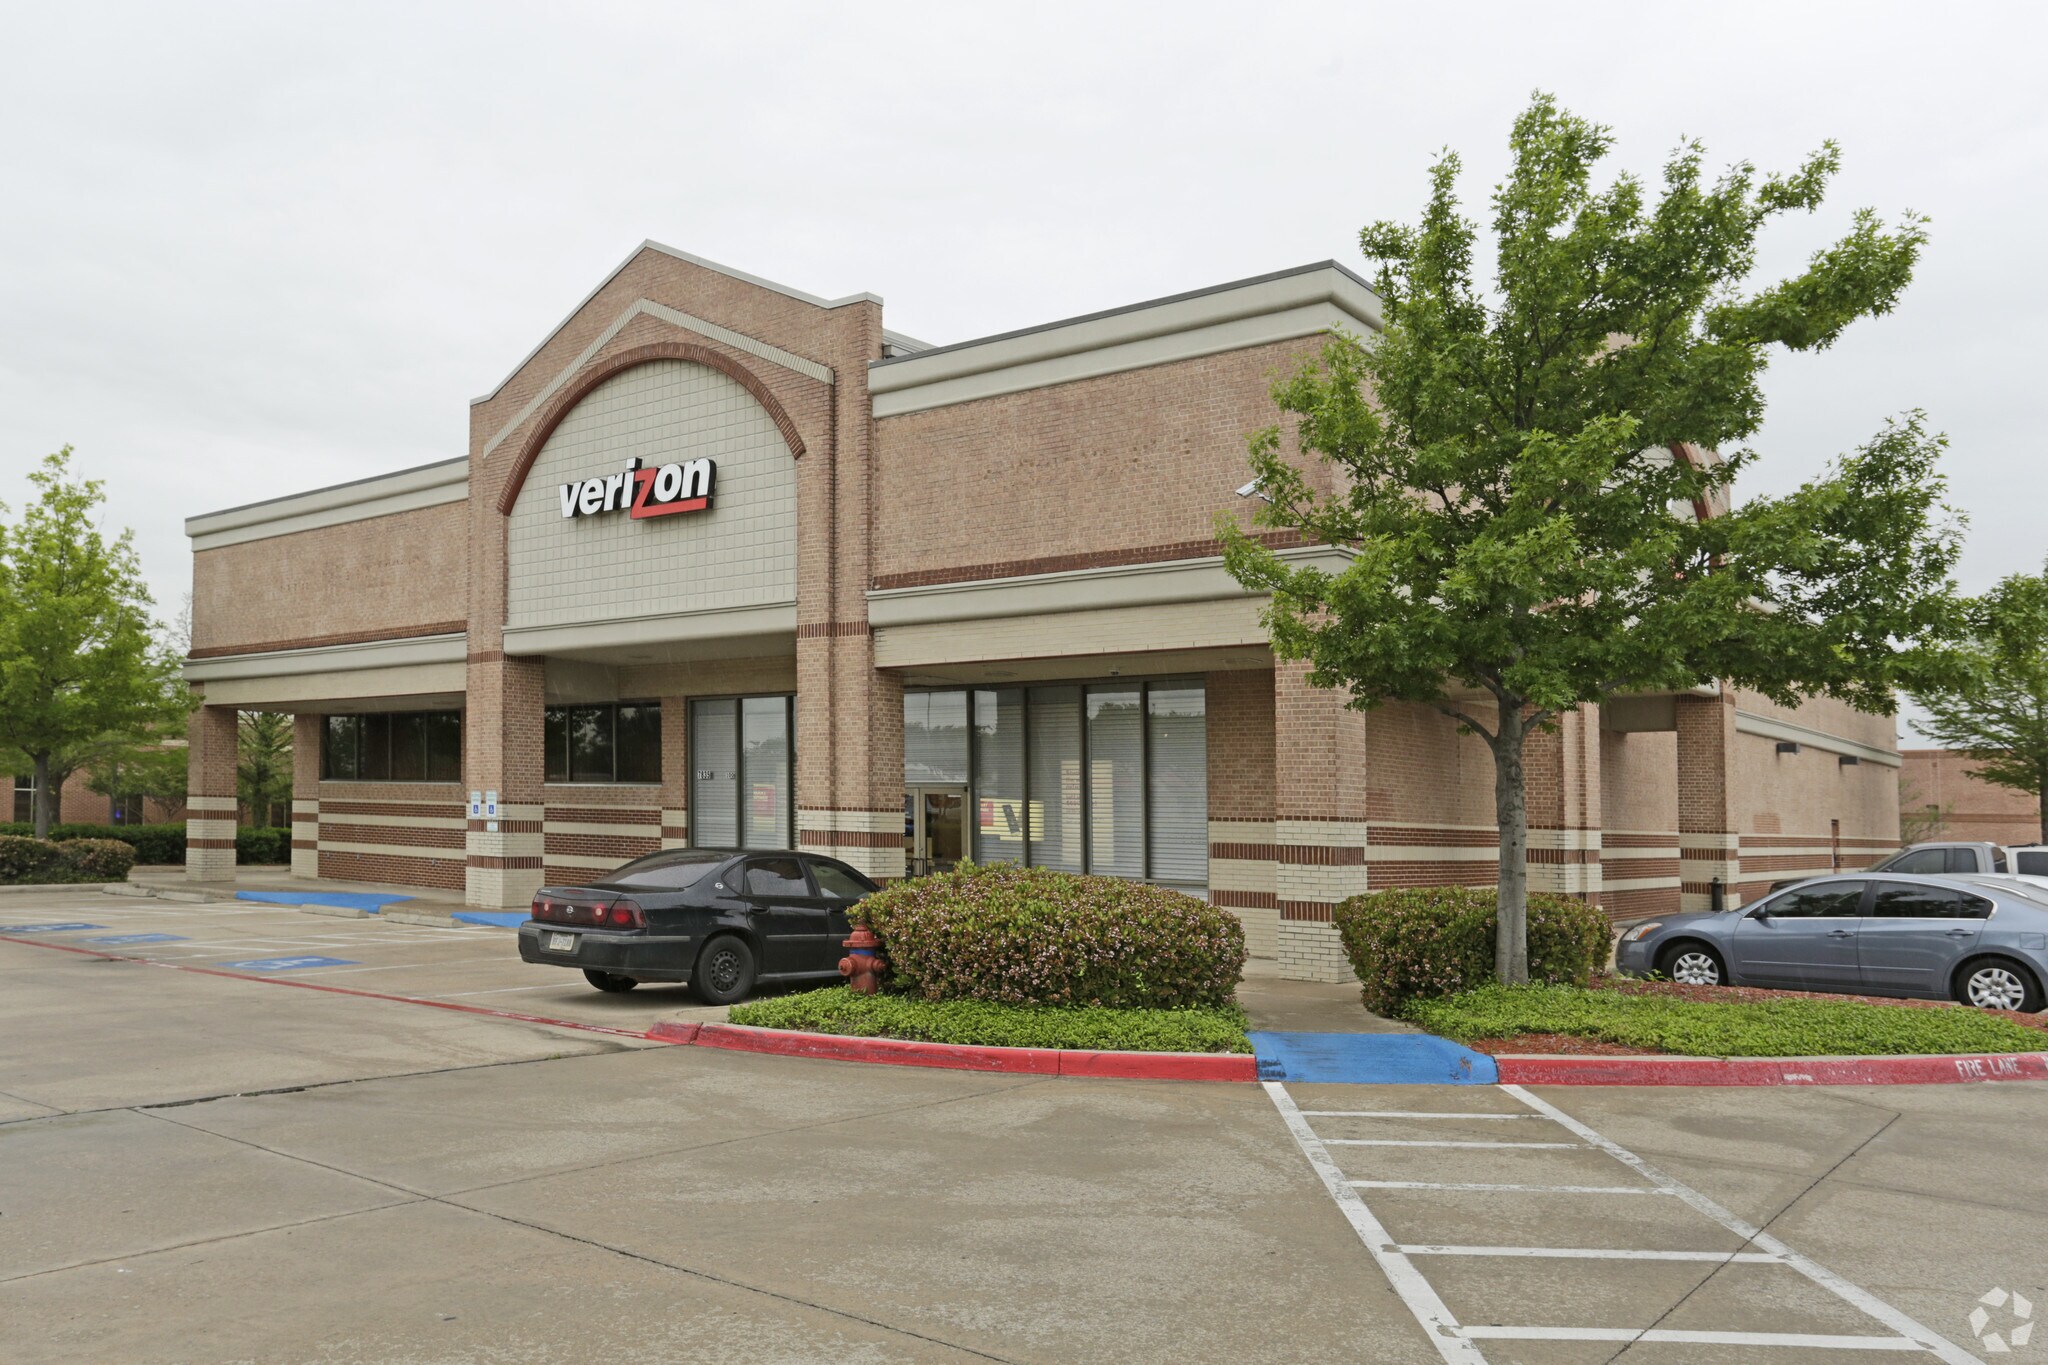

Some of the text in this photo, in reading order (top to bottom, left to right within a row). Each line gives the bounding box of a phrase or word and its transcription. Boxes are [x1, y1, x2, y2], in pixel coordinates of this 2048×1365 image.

[559, 457, 716, 519] verizon
[1955, 1059, 1987, 1078] FIRE
[1987, 1057, 2022, 1076] LANE
